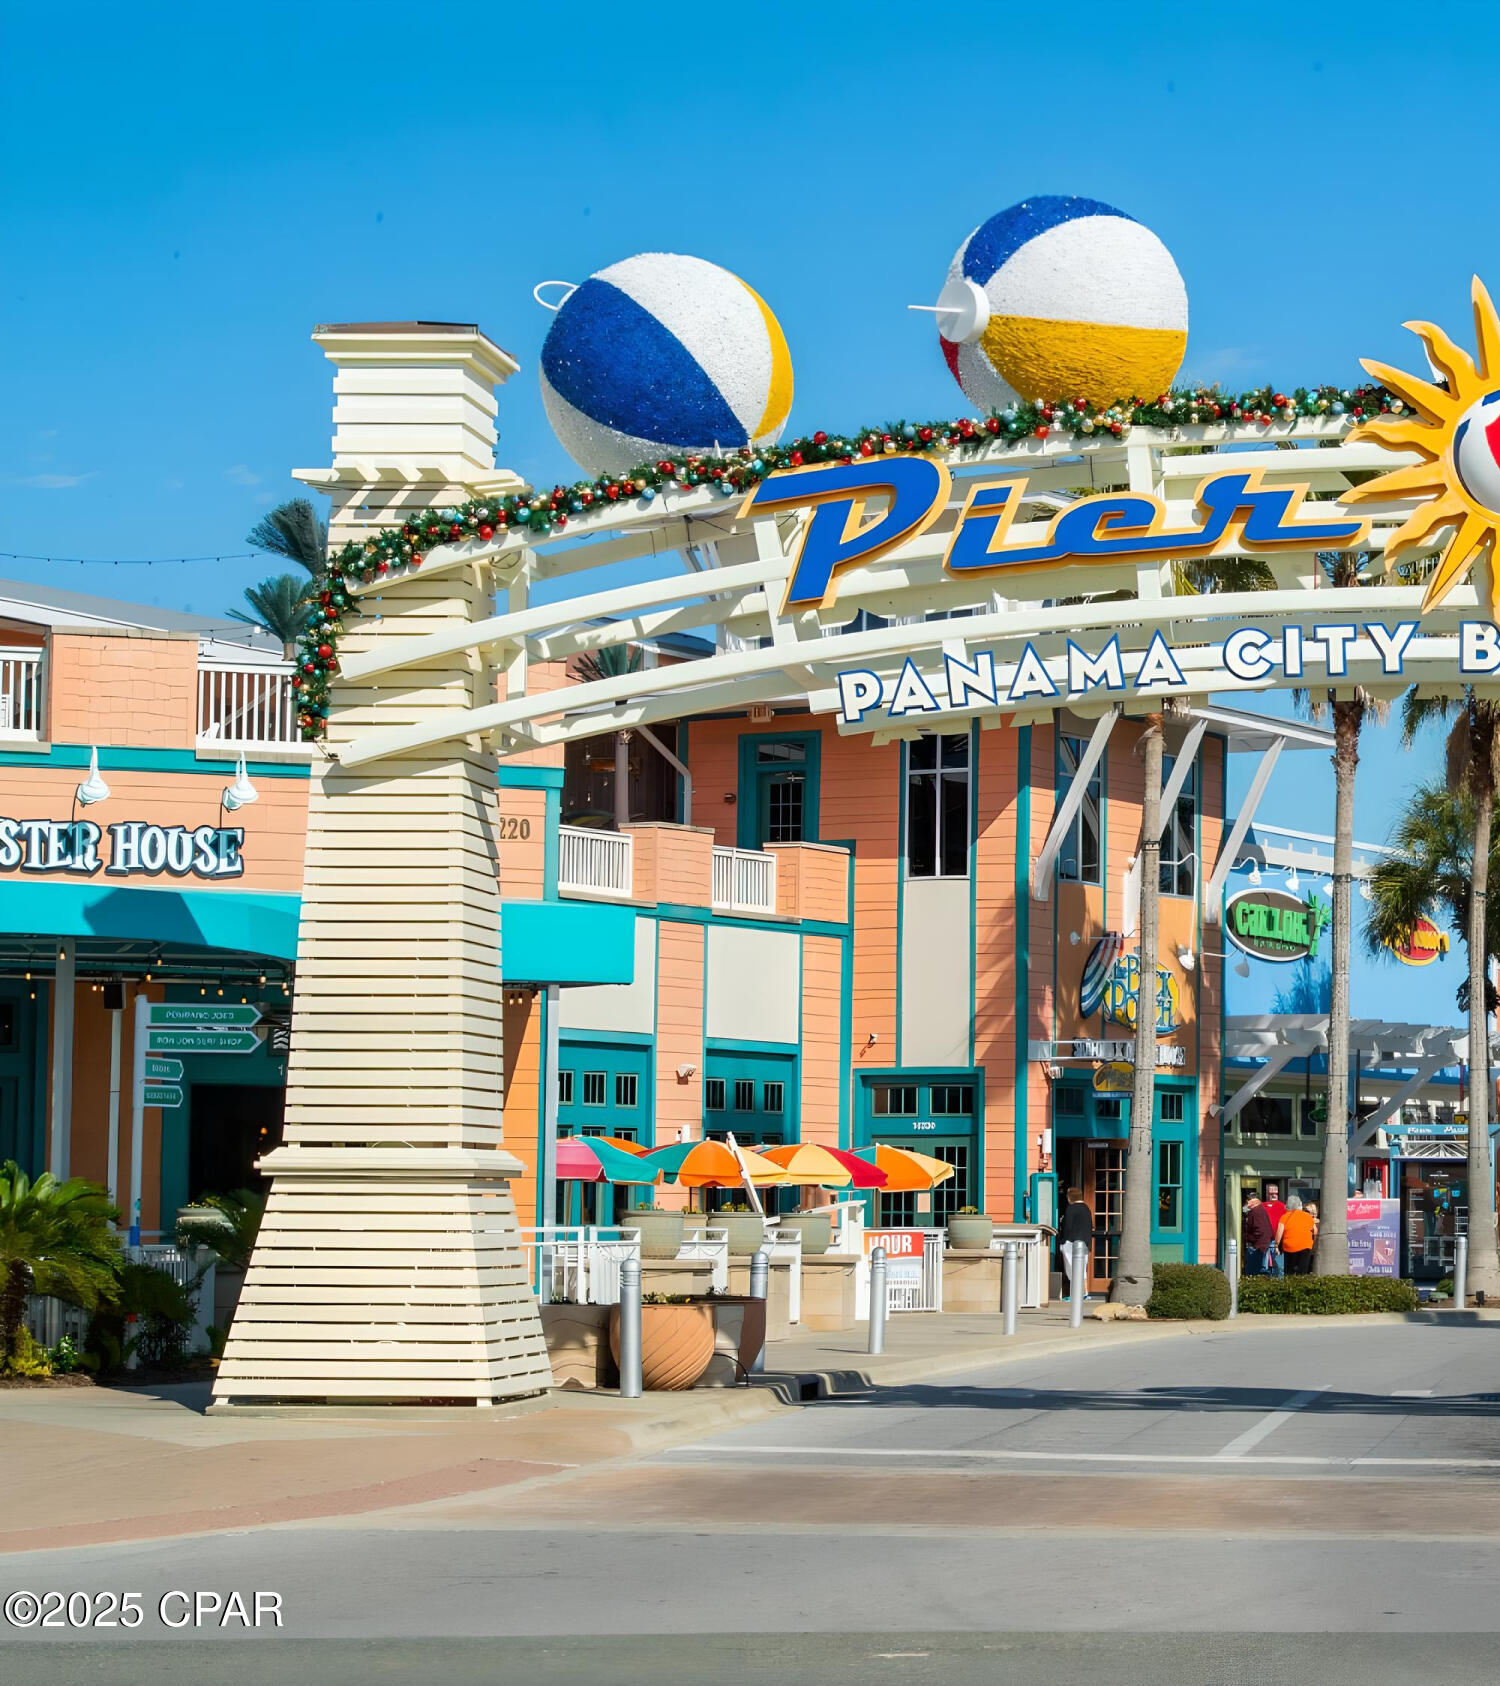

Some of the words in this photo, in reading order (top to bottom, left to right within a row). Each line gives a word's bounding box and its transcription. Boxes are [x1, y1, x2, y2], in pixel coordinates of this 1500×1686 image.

[738, 450, 1371, 617] Pier
[837, 628, 1188, 724] PANAMA
[1222, 621, 1420, 682] CITY
[105, 820, 244, 880] HOUSE
[869, 1233, 913, 1255] HOUR
